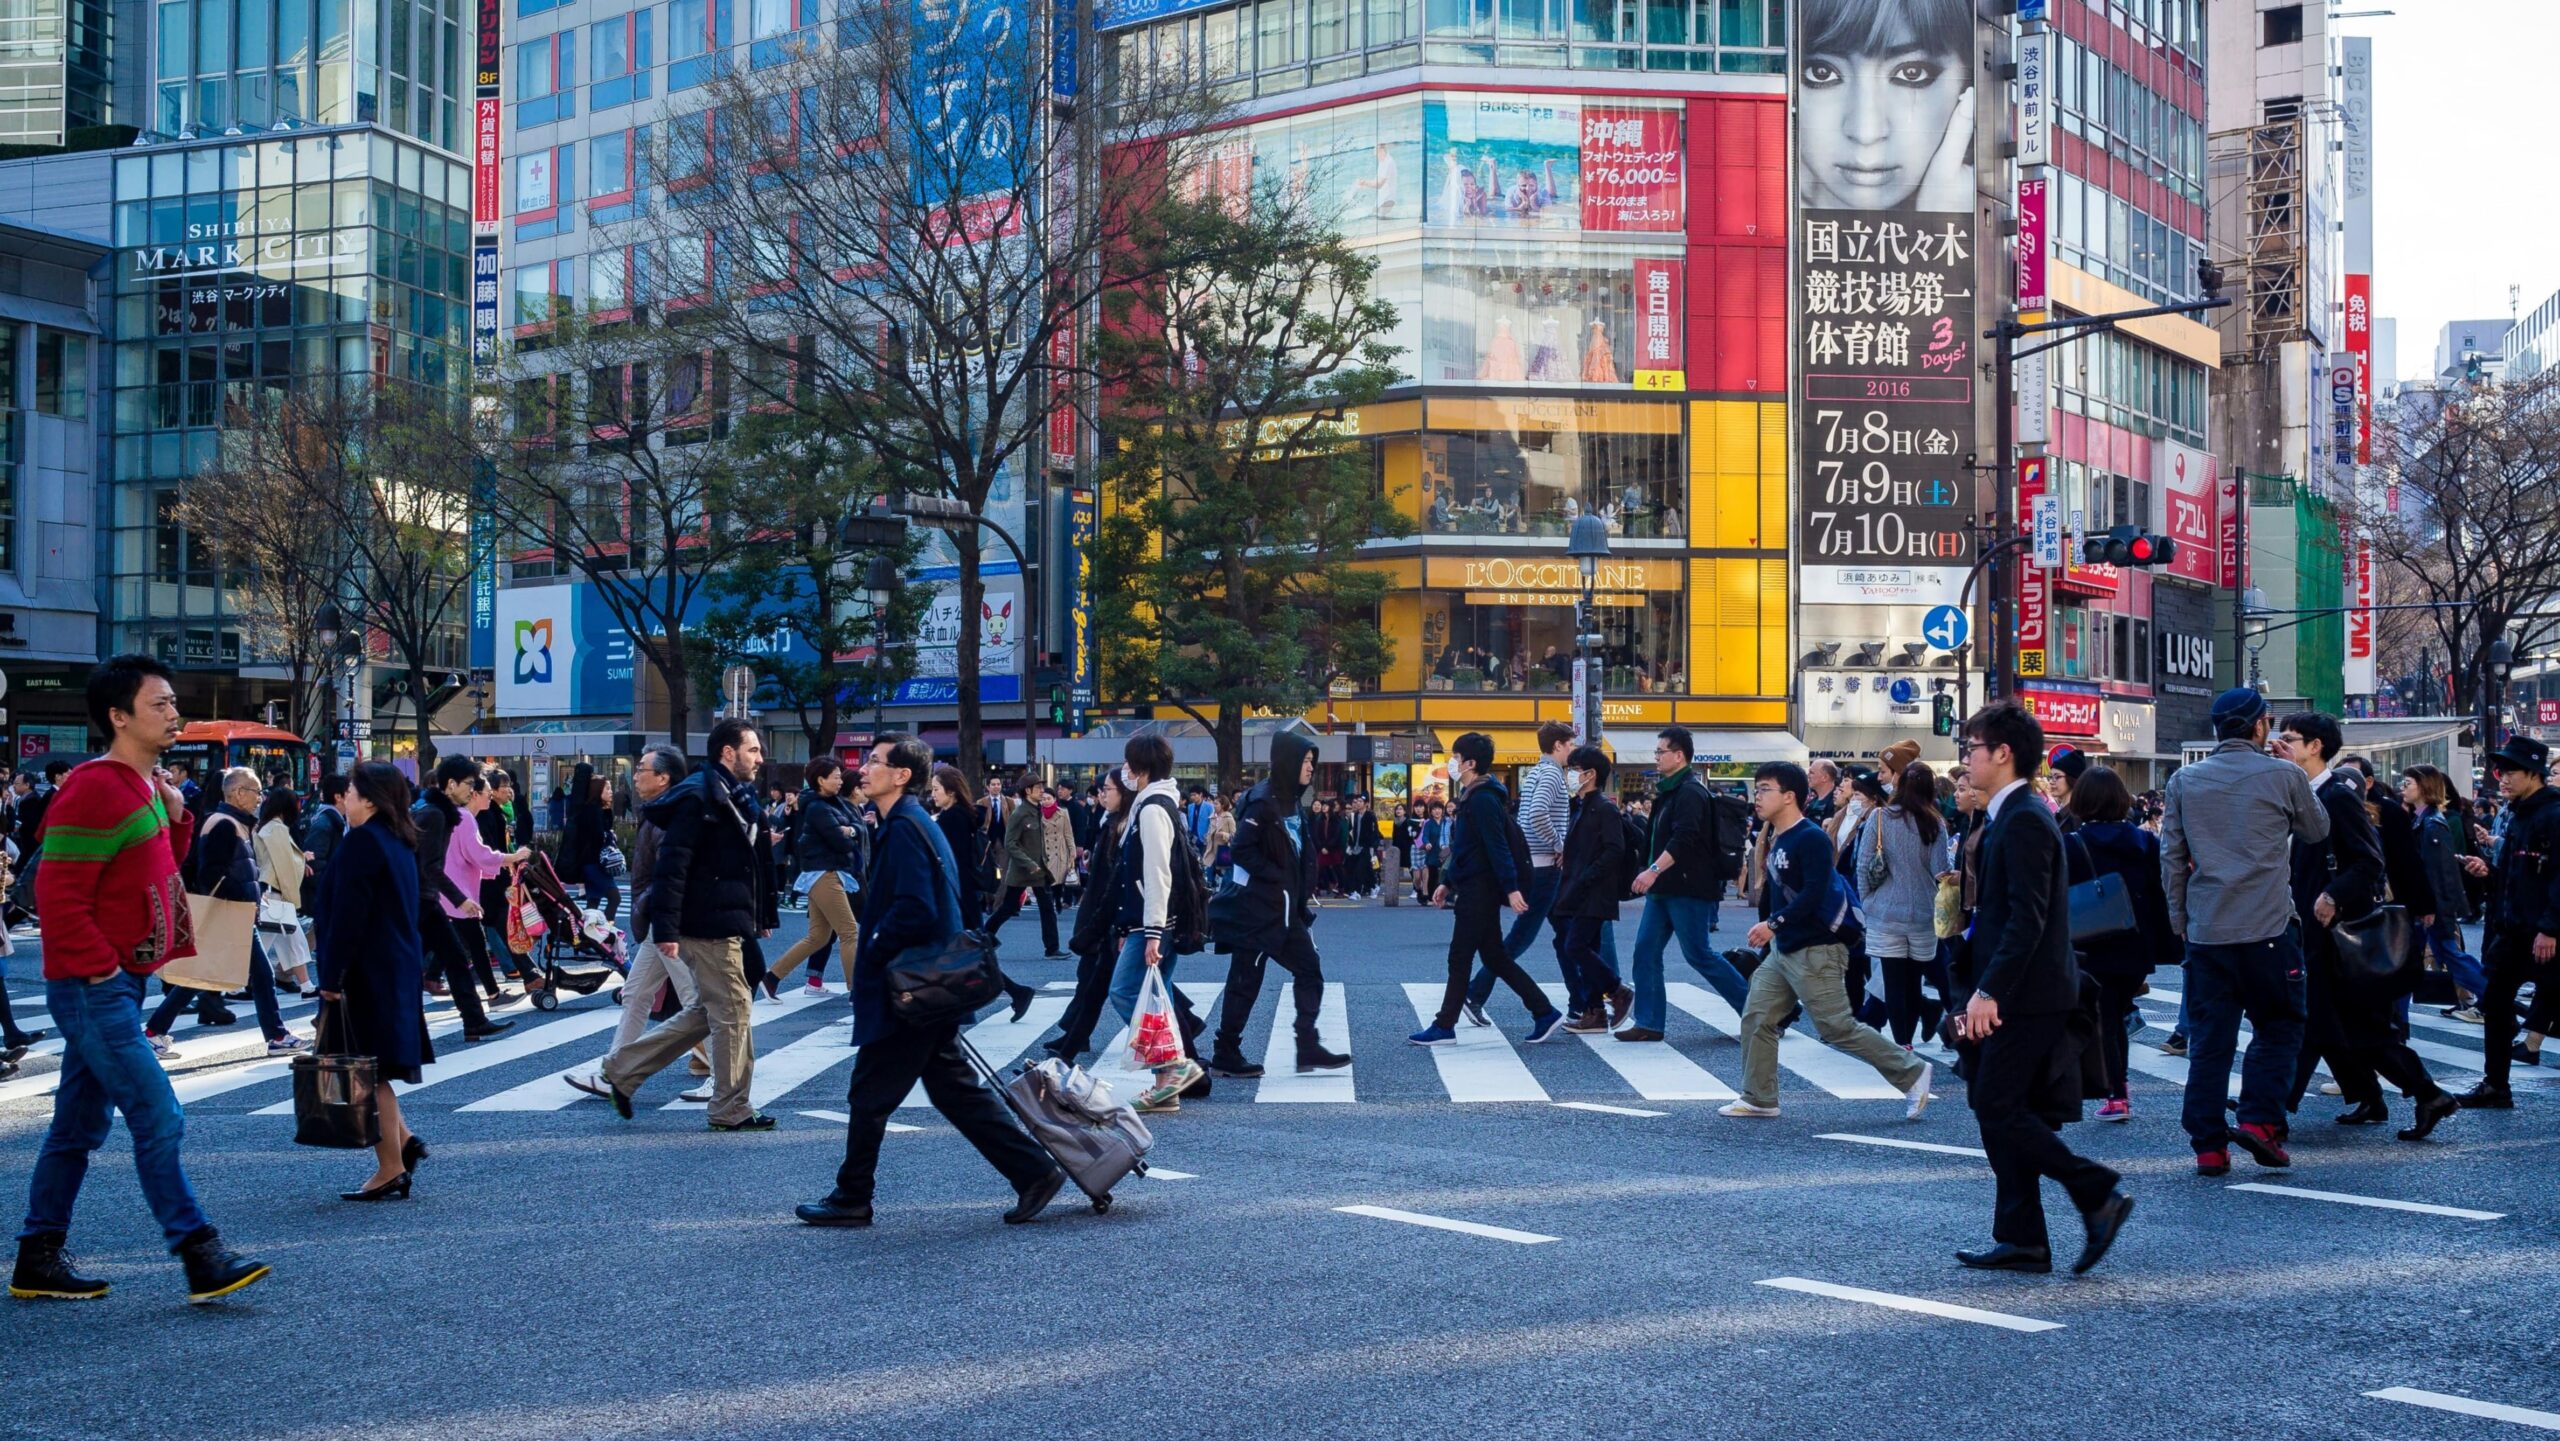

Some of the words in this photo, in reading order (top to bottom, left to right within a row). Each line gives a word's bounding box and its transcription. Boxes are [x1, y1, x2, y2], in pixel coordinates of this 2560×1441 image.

[2024, 9, 2038, 20] 6F
[479, 72, 497, 84] 8F
[2346, 52, 2366, 91] BIC
[2024, 47, 2039, 154] 渋谷駅前ビル
[481, 101, 496, 166] 外貨両替
[1583, 118, 1643, 147] 沖縄
[1583, 151, 1676, 163] フォトウェディング
[1586, 195, 1648, 206] ドレスのまま
[2020, 182, 2044, 197] 5F
[480, 222, 494, 232] 7F
[1617, 210, 1675, 221] 海に入ろう!
[189, 216, 293, 239] SHIBUYA
[135, 243, 245, 271] MARK
[263, 233, 357, 260] CITY
[1806, 219, 1969, 266] 国立代々木
[192, 290, 218, 304] 渋谷
[223, 284, 287, 301] マークシティ
[1805, 269, 1971, 317] 競技場第一
[475, 253, 497, 358] 加藤眼科
[1647, 270, 1670, 360] 毎日開催
[2349, 294, 2367, 332] 免税
[1805, 320, 1912, 367] 体育館
[1928, 316, 1954, 351] 3
[1920, 341, 1967, 373] Days!
[1647, 374, 1672, 388] 4F
[1866, 381, 1910, 397] 2016
[2332, 367, 2354, 404] OS
[1816, 409, 1958, 456] 7月8日(金)
[1816, 460, 1959, 506] 7月9日(土)
[2175, 498, 2207, 539] アコム
[1810, 511, 1966, 557] 7月10日(日)
[2044, 500, 2058, 561] 渋谷駅前
[2223, 524, 2236, 566] アコム
[2186, 550, 2197, 573] 3F
[1499, 594, 1517, 604] EN
[1528, 594, 1614, 605] PROVECE
[2021, 550, 2043, 641] ドラッグ
[185, 637, 214, 646] SHIBUY
[924, 626, 961, 642] 献血ル
[167, 643, 206, 655] MRK
[206, 646, 236, 657] CTY
[2166, 633, 2213, 679] LUSH
[2022, 651, 2043, 673] 薬
[1817, 676, 1971, 693] 渋谷駅ビ
[1568, 704, 1643, 715] LCITANE
[2050, 703, 2089, 724] サンドラッグ
[2113, 708, 2140, 730] QIANA
[2540, 703, 2556, 712] UNI
[2541, 712, 2557, 722] QLO
[2119, 732, 2136, 742] BAGS
[1693, 753, 1732, 761] KIOSQUE
